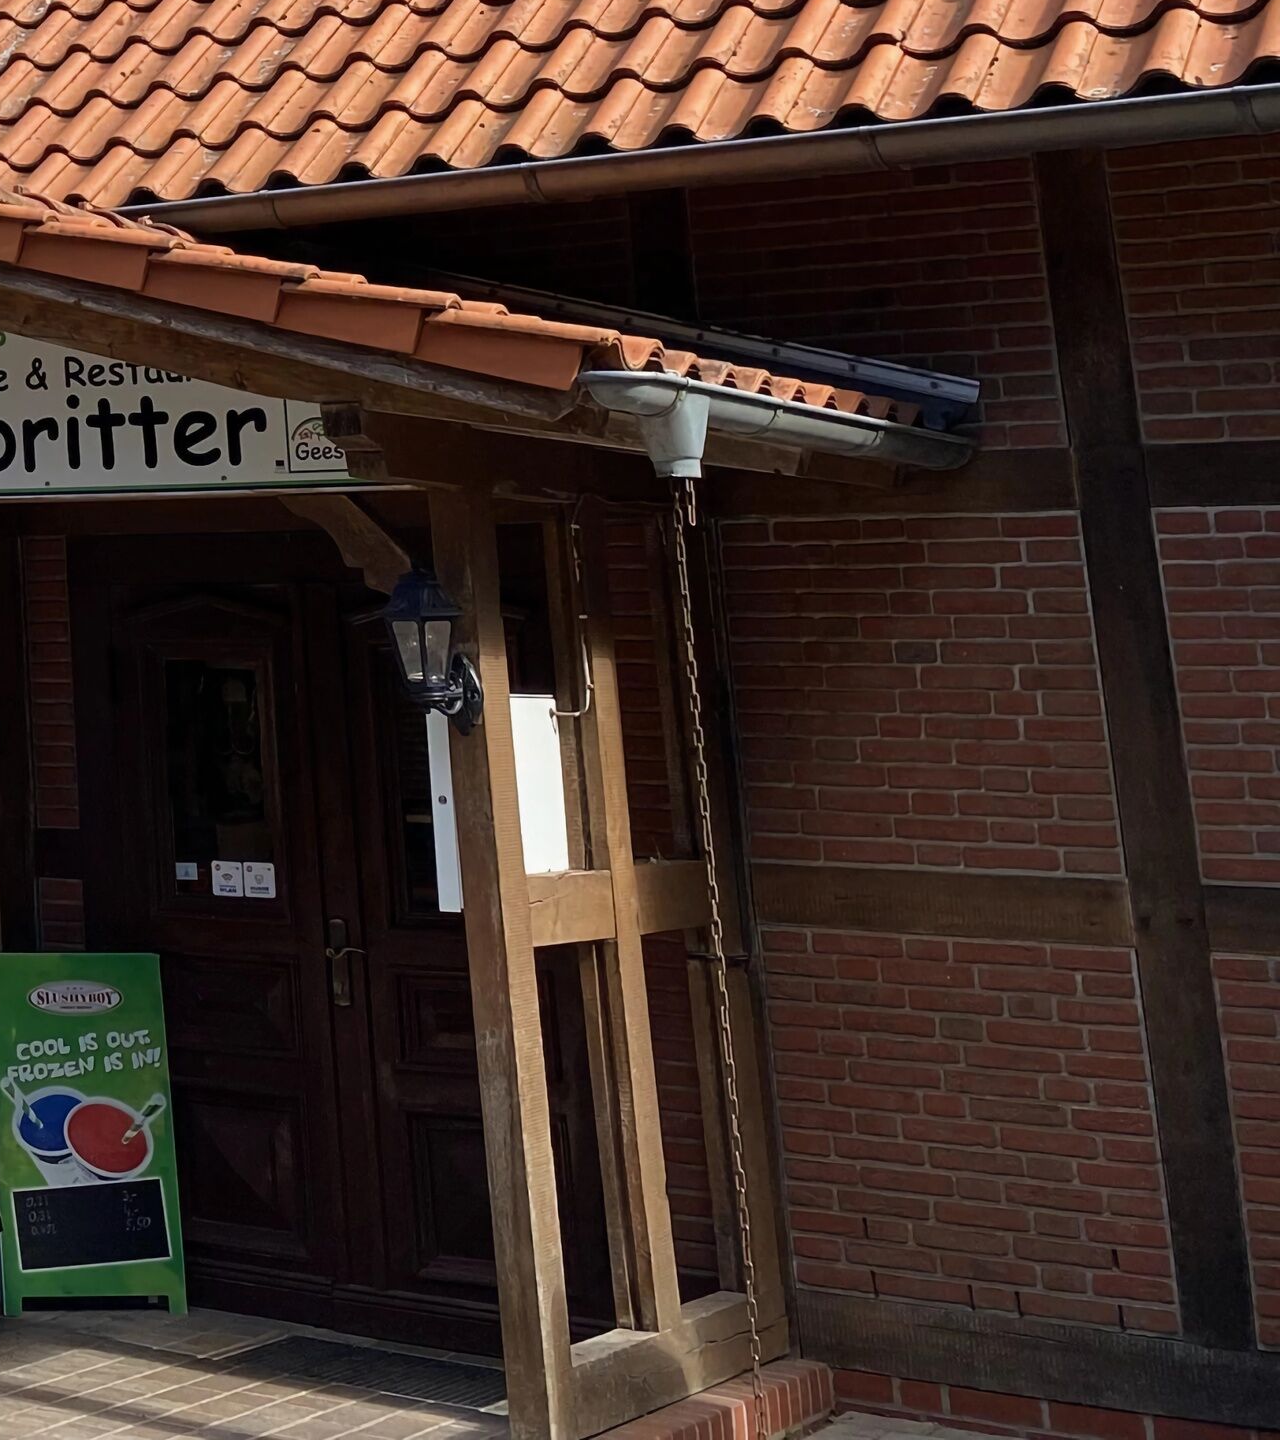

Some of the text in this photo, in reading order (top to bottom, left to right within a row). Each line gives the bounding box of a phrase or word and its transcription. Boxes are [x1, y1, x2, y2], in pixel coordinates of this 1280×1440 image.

[25, 357, 48, 390] &
[36, 991, 115, 1005] SLUSHYBOY
[16, 1029, 150, 1060] COOL IS OUT.
[7, 1047, 161, 1082] FROZEN IS IN!
